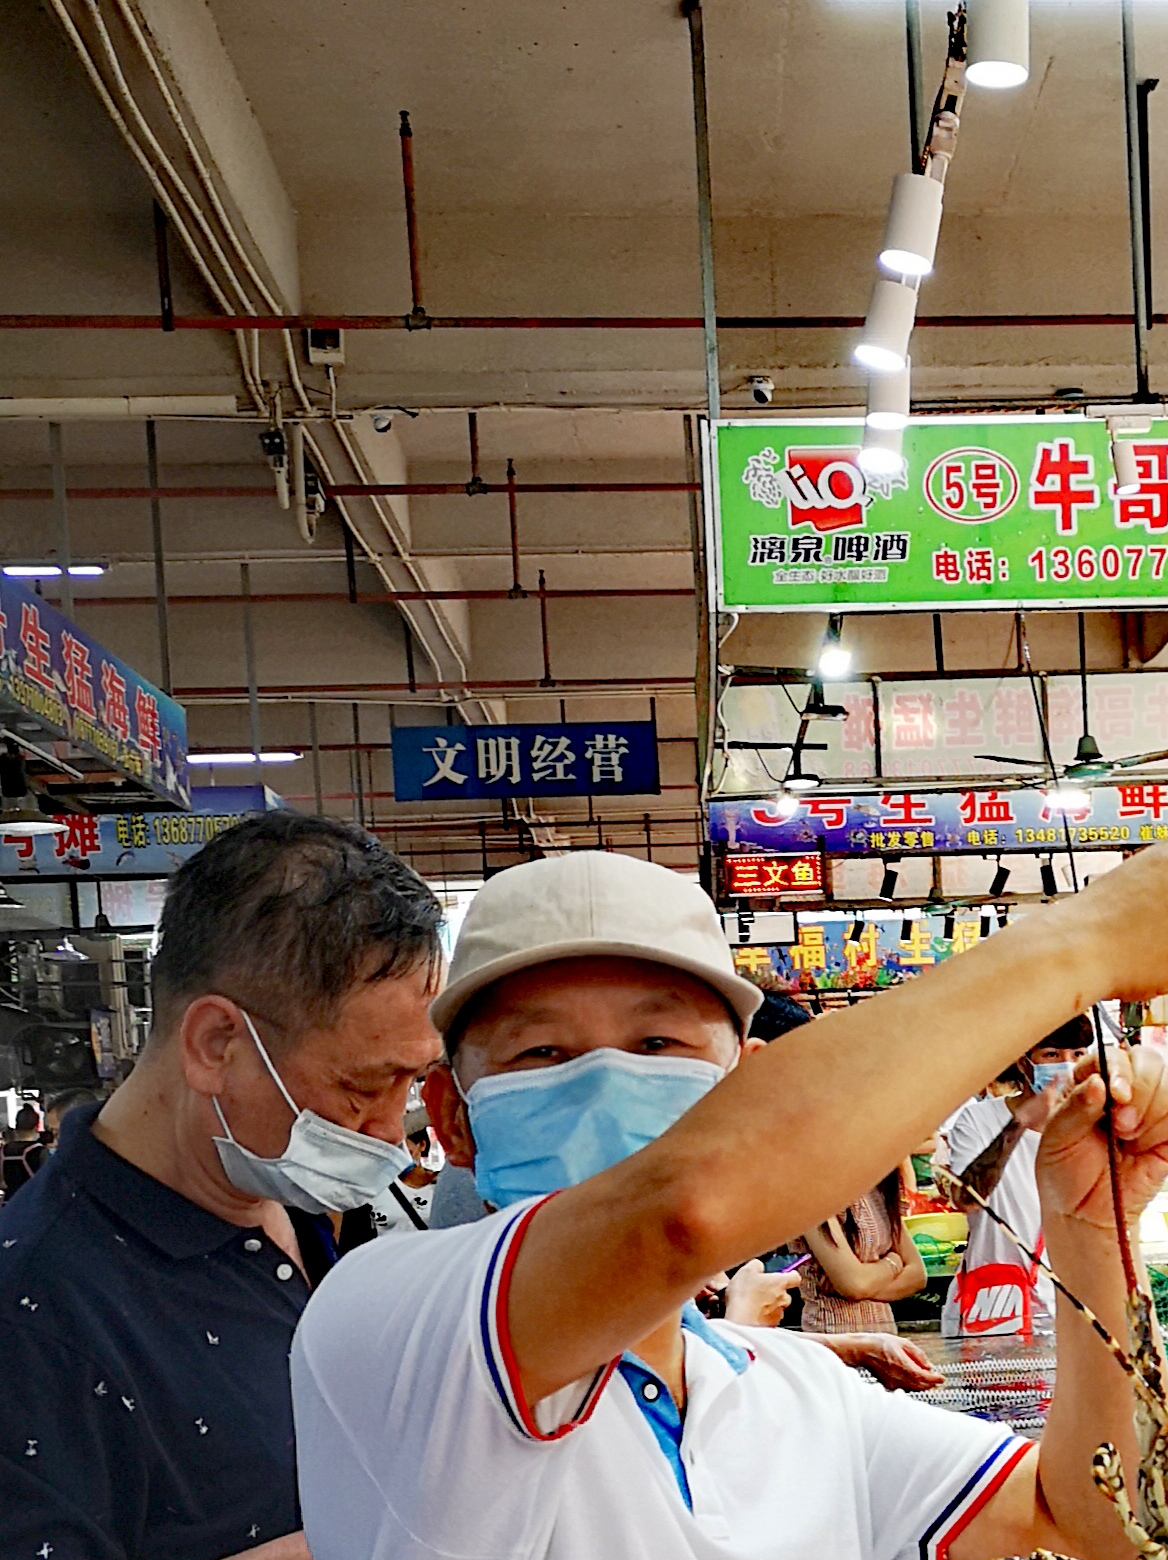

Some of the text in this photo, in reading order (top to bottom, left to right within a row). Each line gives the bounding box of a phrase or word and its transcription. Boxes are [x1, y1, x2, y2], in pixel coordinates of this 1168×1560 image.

[944, 463, 1001, 510] 5号
[421, 733, 630, 786] 文明经营
[869, 831, 935, 848] 批发零售
[733, 861, 822, 887] 三文鱼
